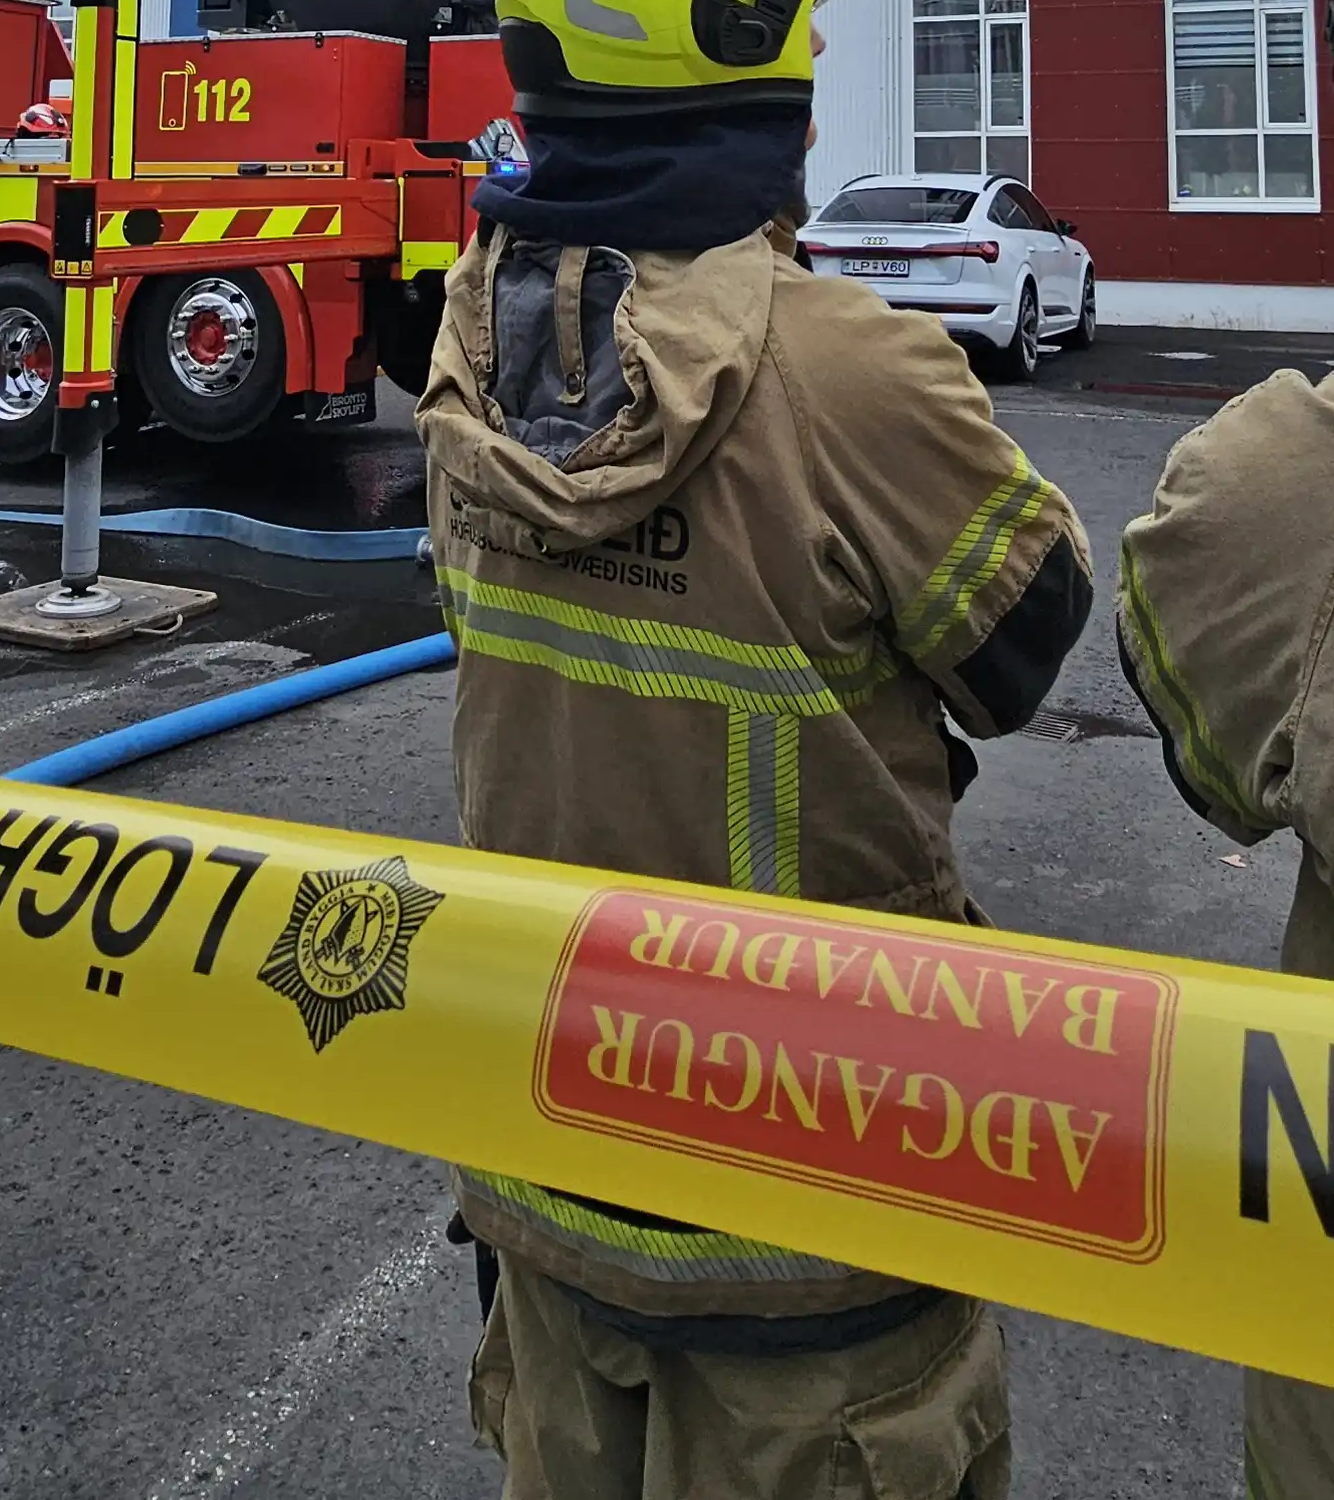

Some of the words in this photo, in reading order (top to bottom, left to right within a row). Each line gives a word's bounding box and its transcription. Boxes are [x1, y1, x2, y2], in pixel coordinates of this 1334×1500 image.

[193, 78, 251, 122] 112
[852, 261, 870, 272] LP
[881, 261, 906, 272] V60
[628, 908, 1126, 1056] BANNAÐUR
[586, 1004, 1115, 1193] AÐGANGUR
